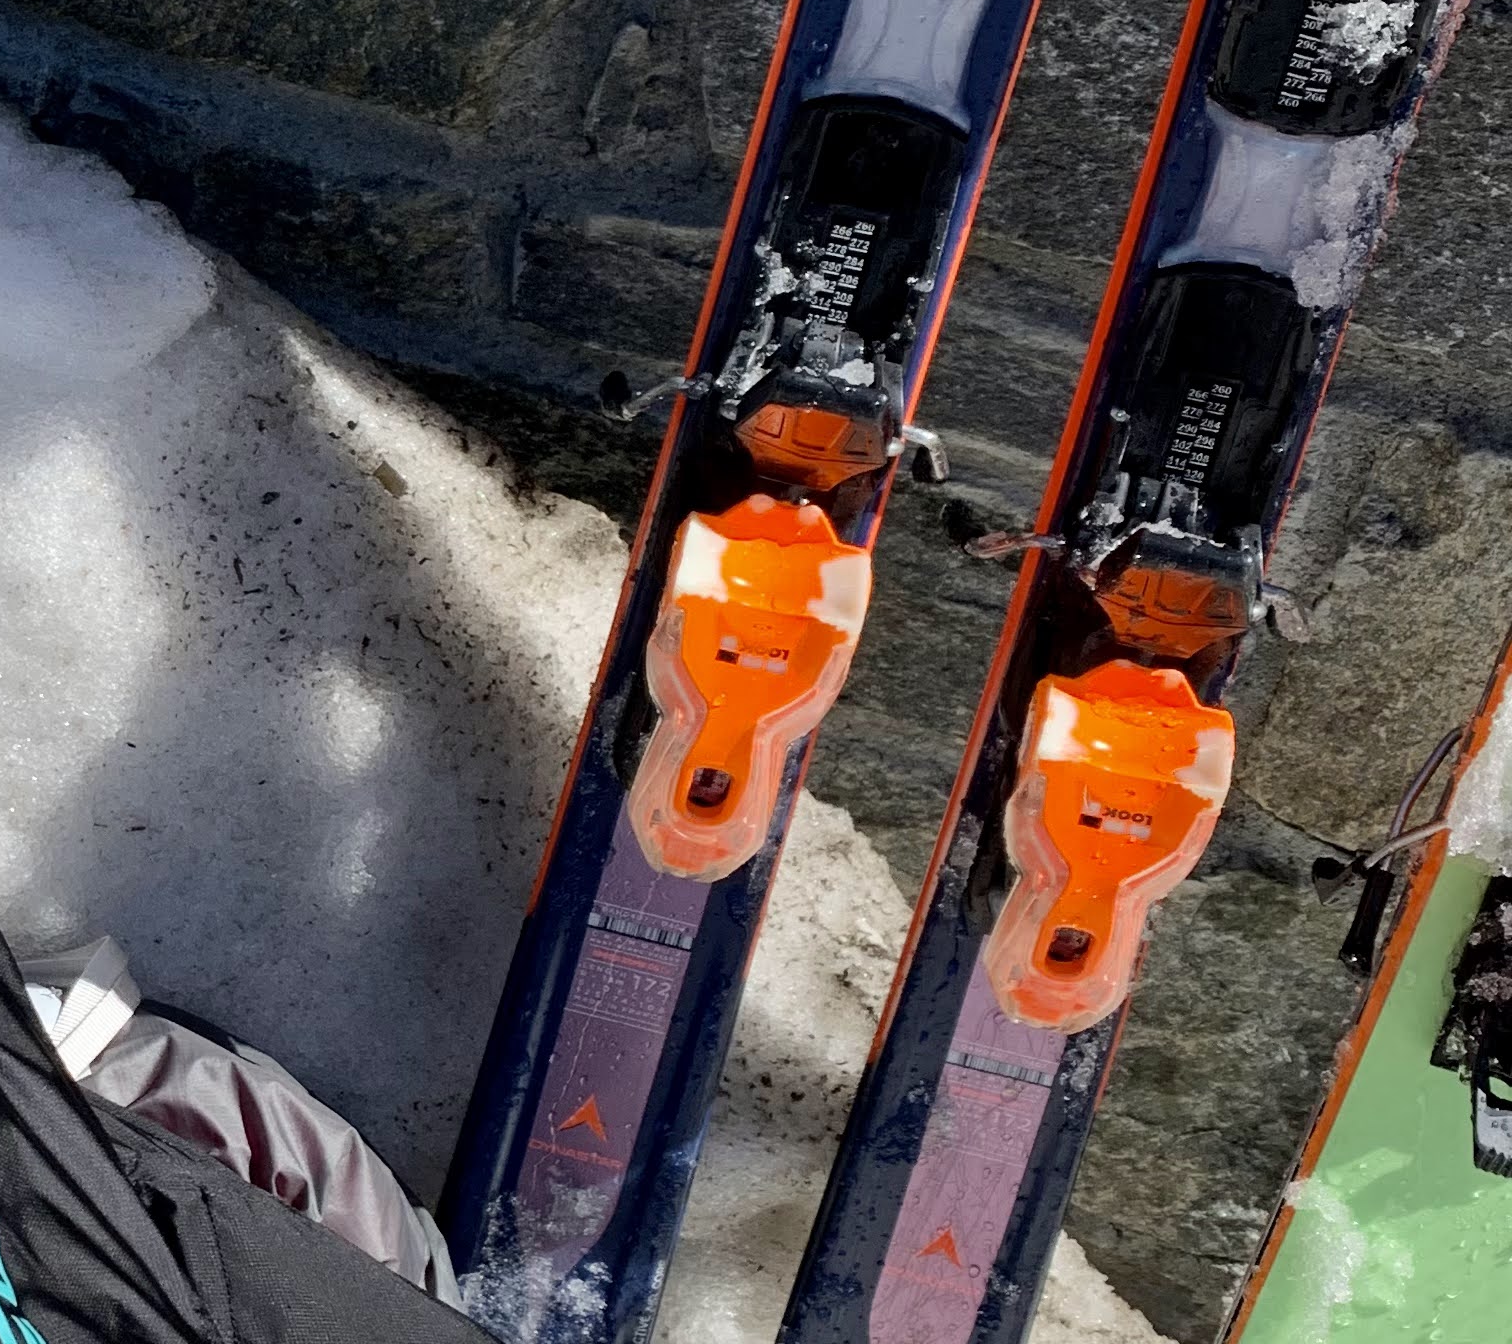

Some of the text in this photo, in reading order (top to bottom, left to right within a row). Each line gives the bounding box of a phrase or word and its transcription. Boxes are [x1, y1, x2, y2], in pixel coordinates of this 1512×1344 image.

[1296, 39, 1317, 51] 296
[1289, 58, 1311, 69] 284
[1283, 78, 1305, 89] 272
[1310, 73, 1332, 84] 278
[1278, 96, 1299, 107] 260
[1304, 92, 1325, 102] 266
[832, 225, 852, 236] 266
[827, 243, 847, 254] 278
[849, 238, 870, 250] 272
[821, 261, 842, 272] 290
[844, 256, 864, 267] 284
[810, 296, 831, 307] 314
[1188, 388, 1208, 399] 266
[1211, 384, 1232, 395] 260
[1207, 402, 1227, 412] 272
[1200, 419, 1221, 429] 284
[1172, 439, 1193, 451] 302
[1194, 435, 1215, 446] 296
[1167, 456, 1187, 467] 314
[1102, 806, 1153, 826] LOOK
[633, 975, 672, 997] 172
[991, 1111, 1032, 1133] 172
